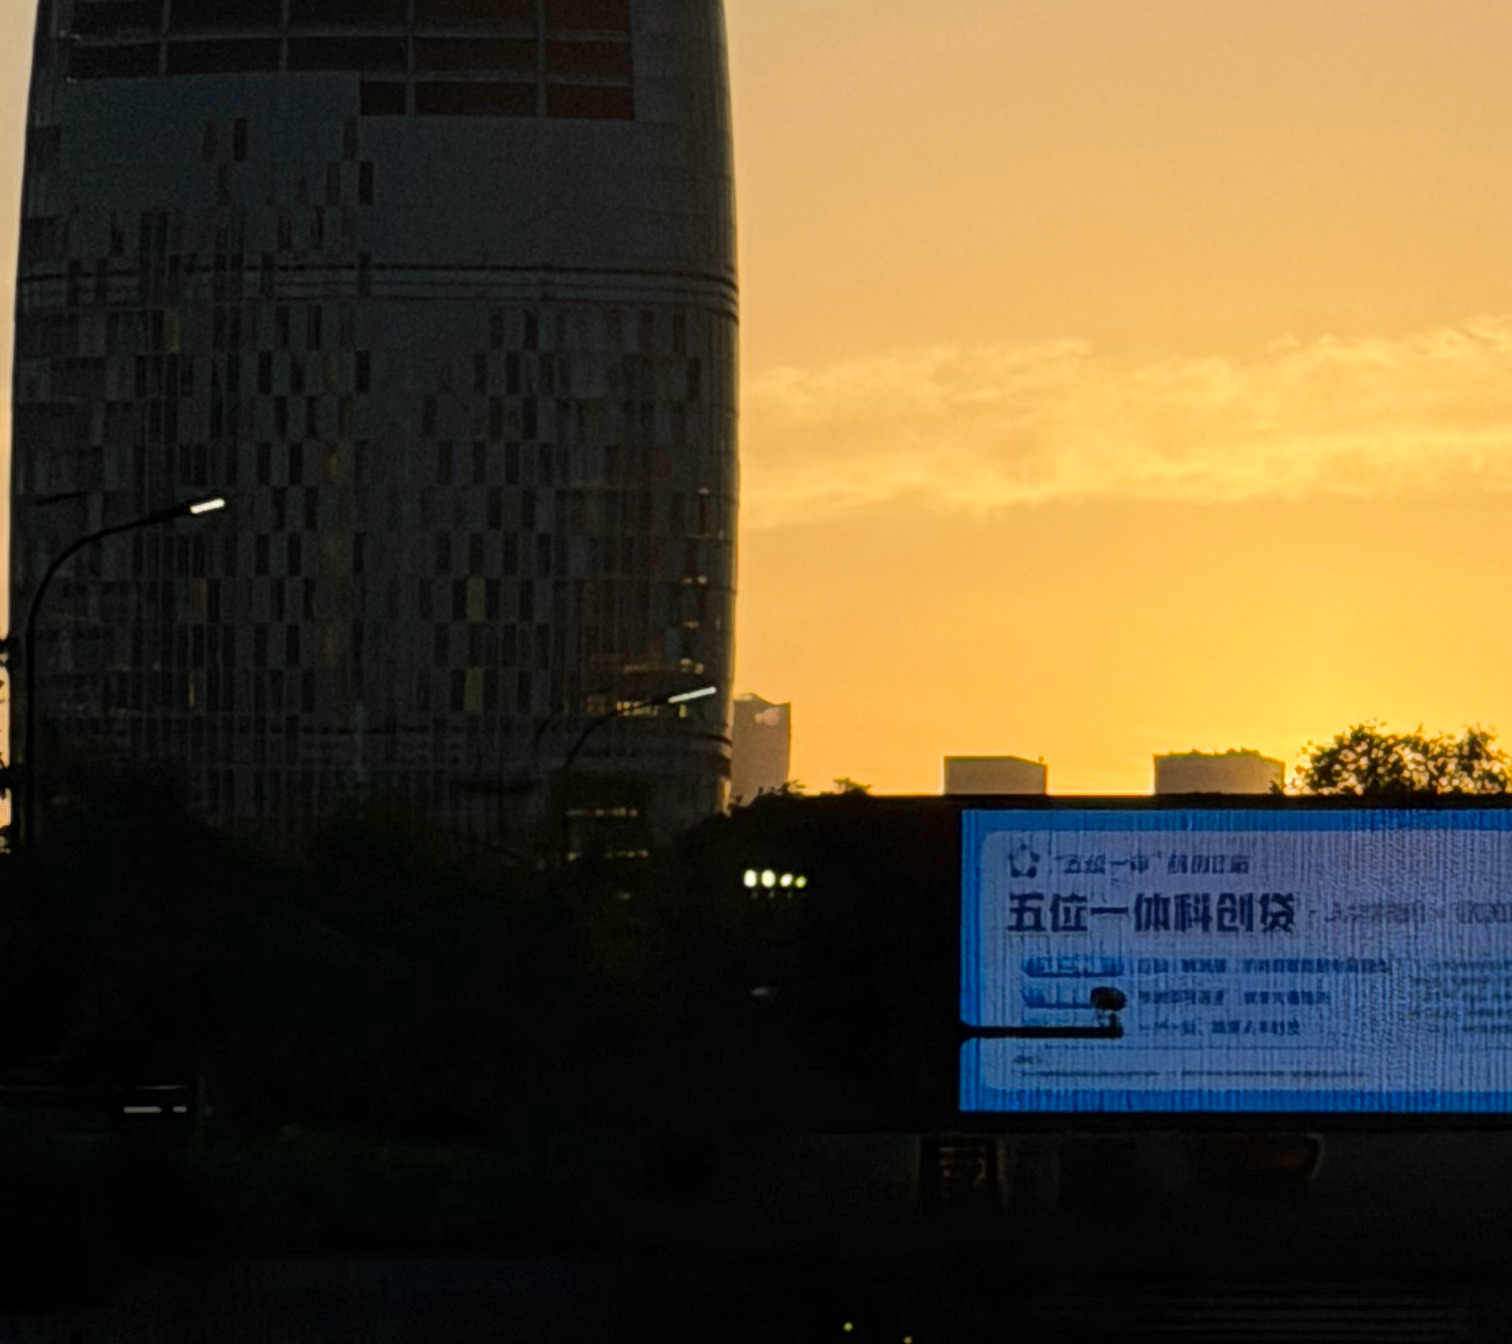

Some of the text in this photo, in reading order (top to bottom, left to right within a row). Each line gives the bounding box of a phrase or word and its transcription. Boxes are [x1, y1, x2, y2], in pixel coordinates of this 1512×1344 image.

[1007, 891, 1296, 933] 五位一体科创贷
